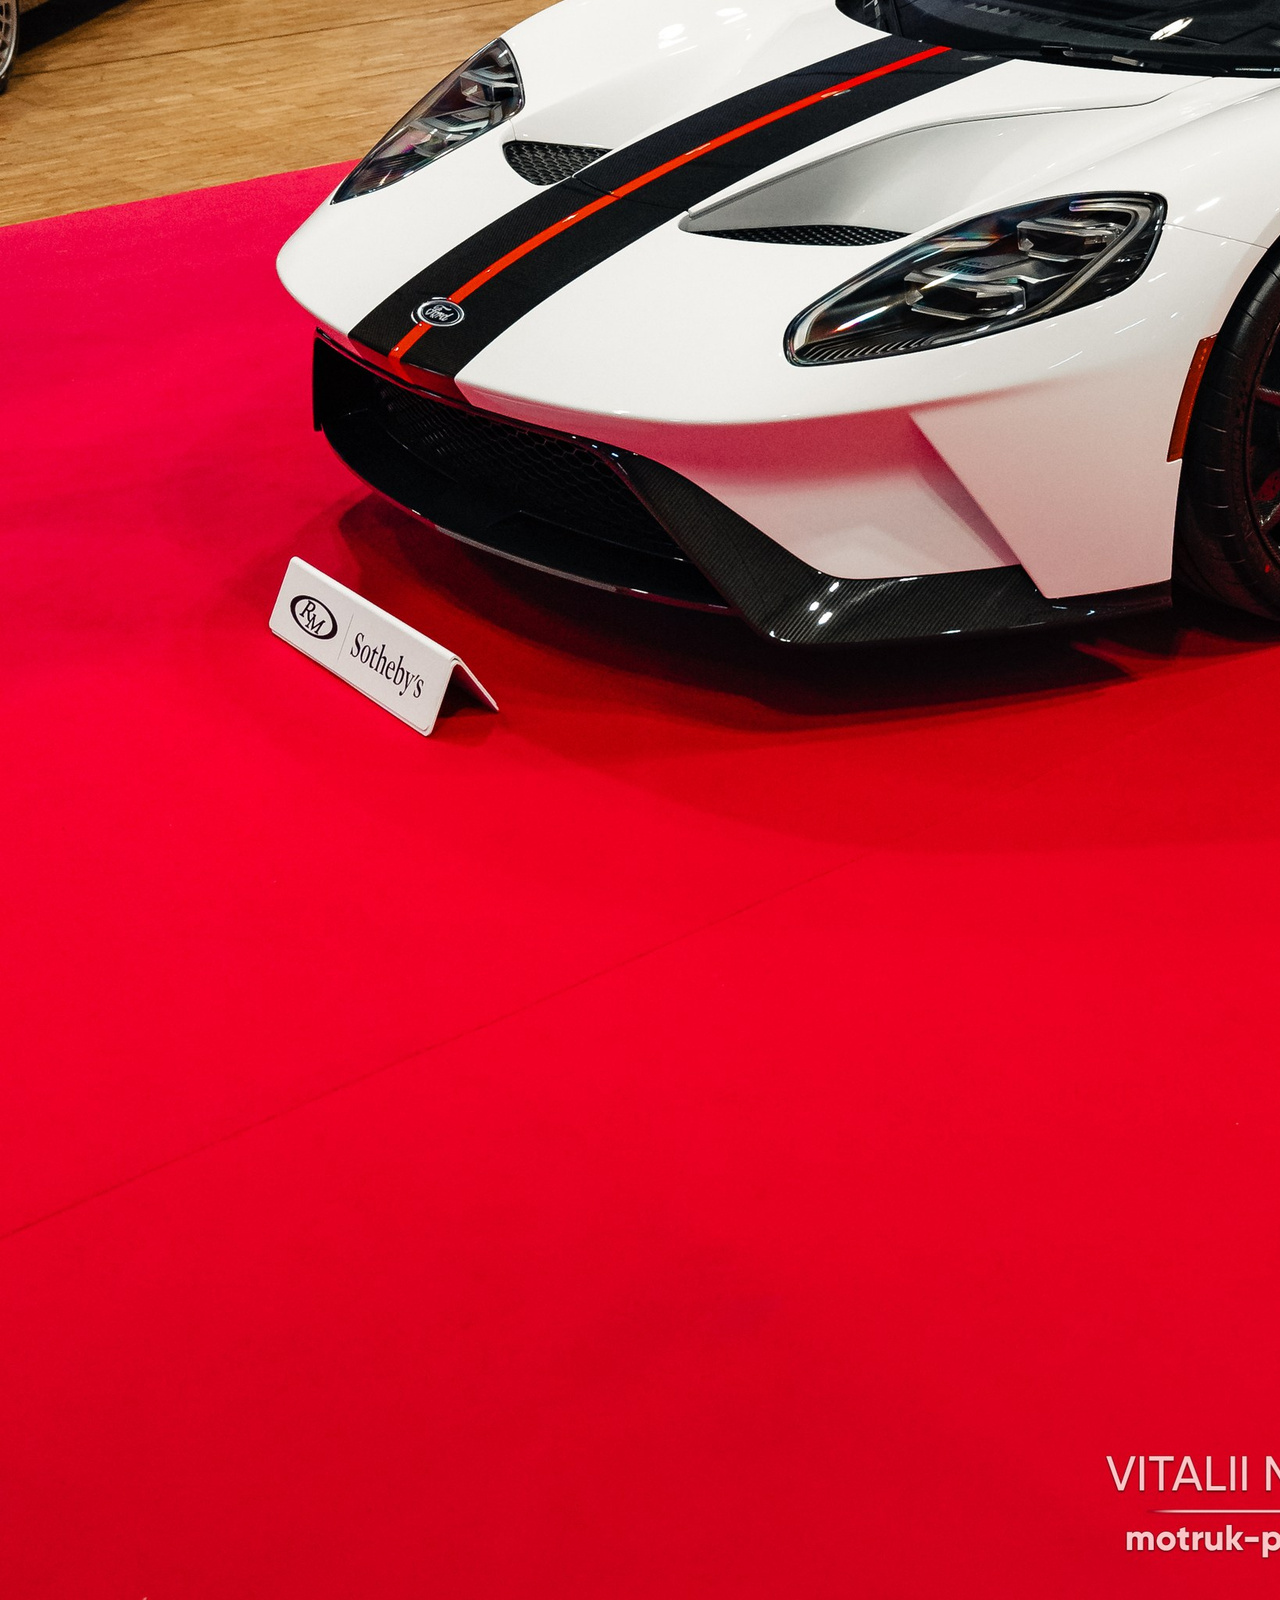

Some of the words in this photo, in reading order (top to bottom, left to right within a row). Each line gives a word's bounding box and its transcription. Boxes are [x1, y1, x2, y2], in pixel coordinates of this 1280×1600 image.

[424, 304, 455, 321] Ford
[297, 598, 329, 637] RM
[349, 632, 425, 699] Sotheby's
